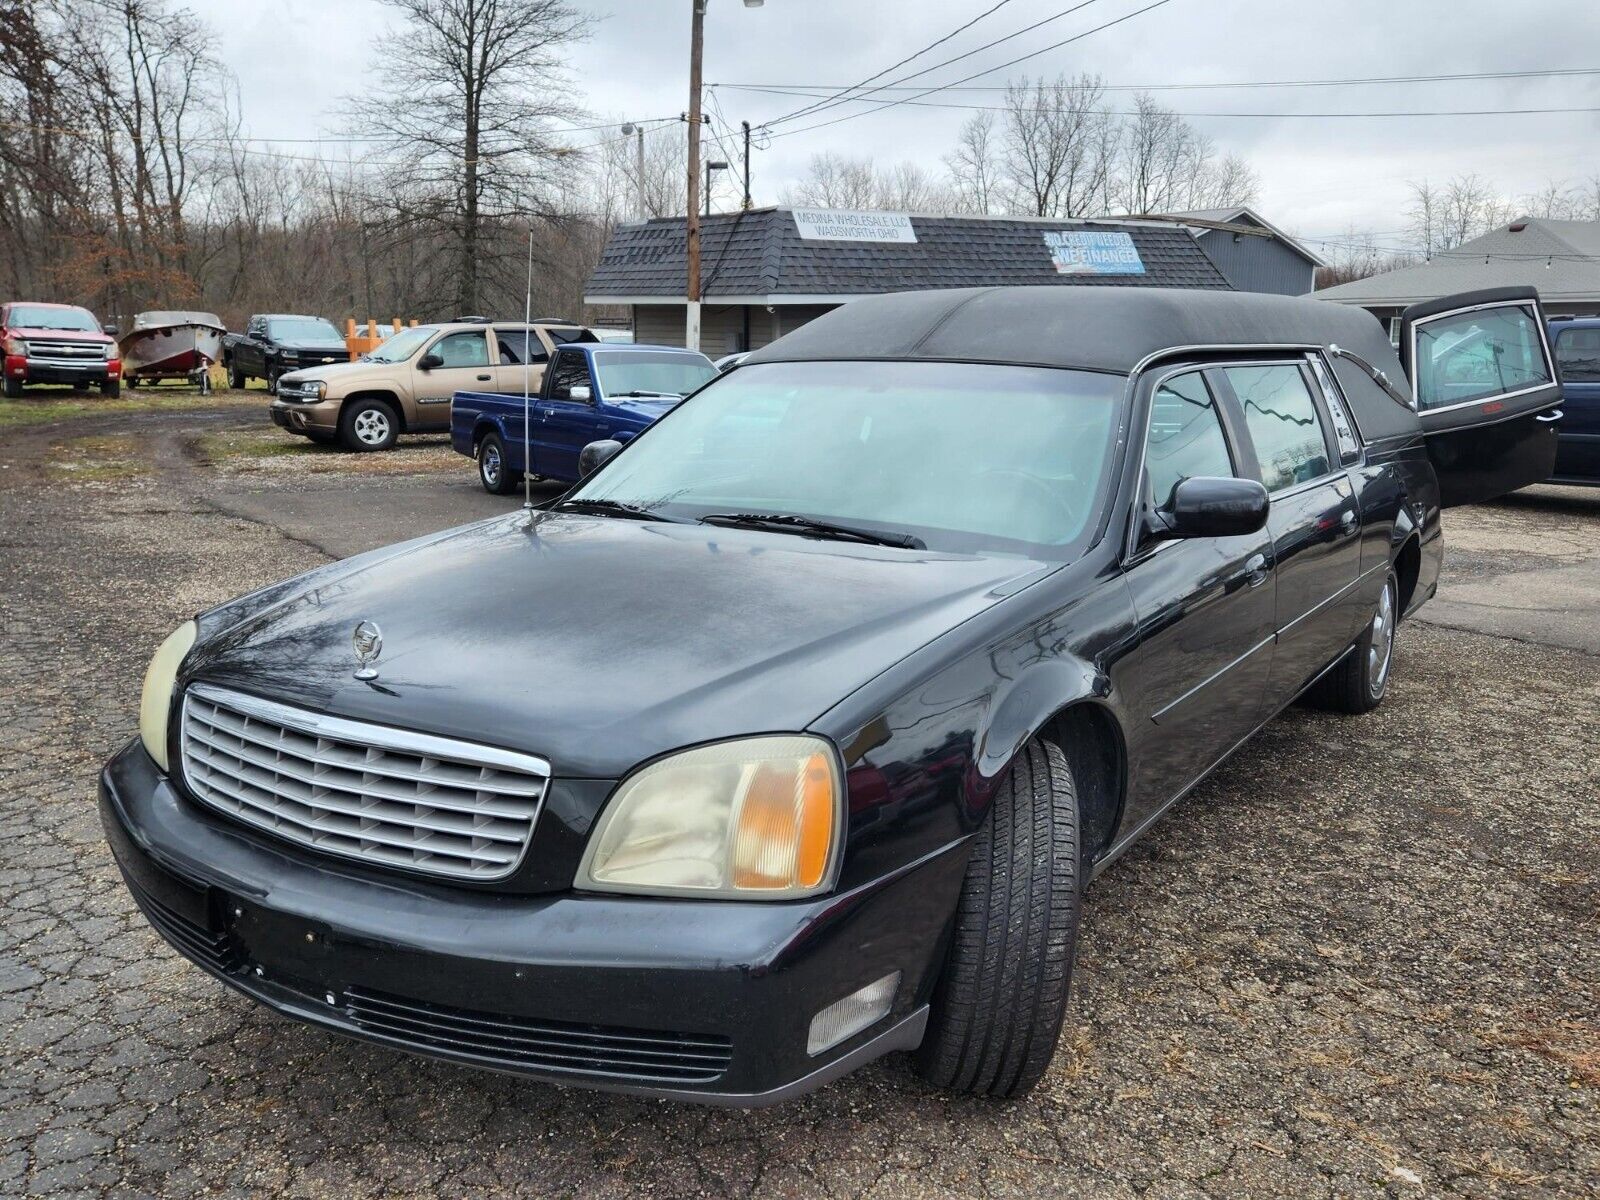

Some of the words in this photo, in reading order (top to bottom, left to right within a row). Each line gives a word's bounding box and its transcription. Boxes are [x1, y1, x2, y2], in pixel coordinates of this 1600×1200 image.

[797, 212, 833, 224] MEDINA
[835, 213, 889, 227] WHOLESALE
[890, 216, 908, 228] LLC
[814, 225, 876, 239] WADSWORTH
[877, 228, 900, 239] OHIO
[1079, 248, 1138, 264] FINANCE
